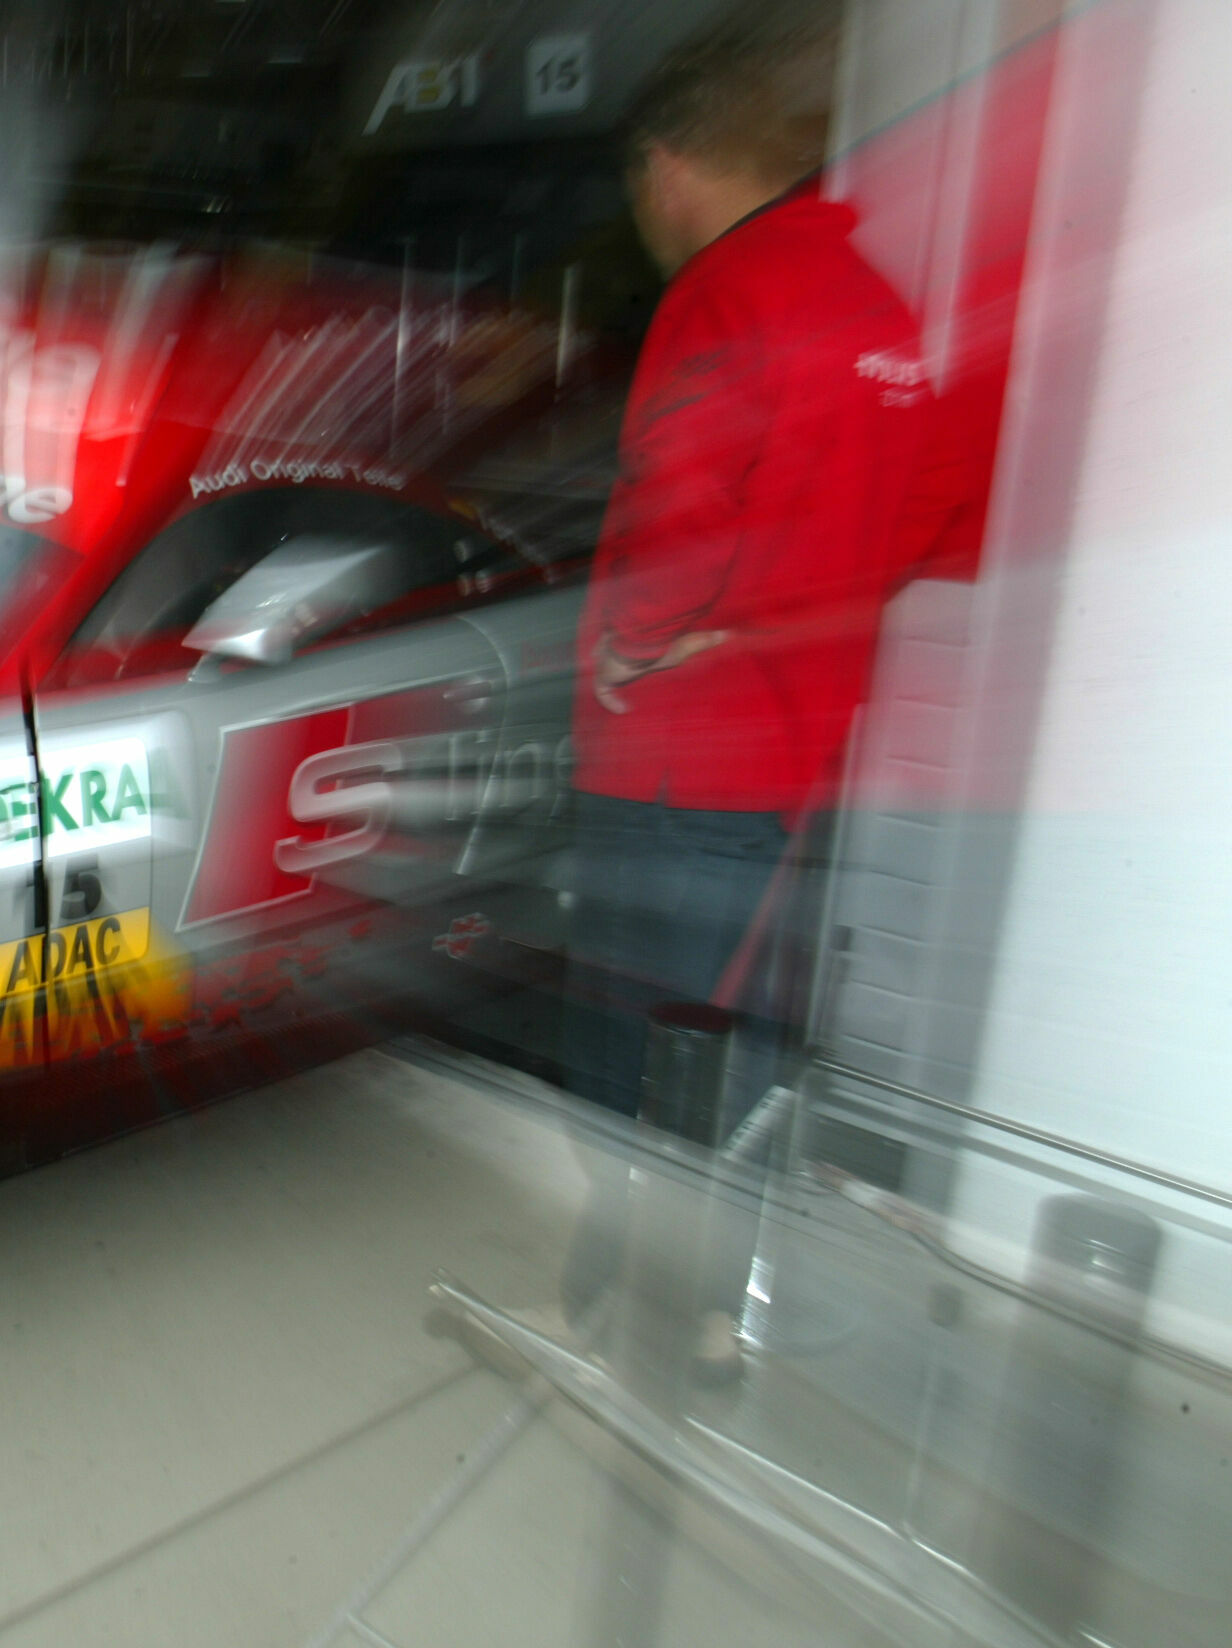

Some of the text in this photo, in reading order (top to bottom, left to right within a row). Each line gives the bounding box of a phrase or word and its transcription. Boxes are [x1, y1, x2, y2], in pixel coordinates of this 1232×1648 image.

[534, 55, 583, 97] 15
[189, 462, 249, 499] Audi
[250, 458, 345, 484] Original
[273, 742, 403, 873] S
[6, 916, 121, 994] ADAC
